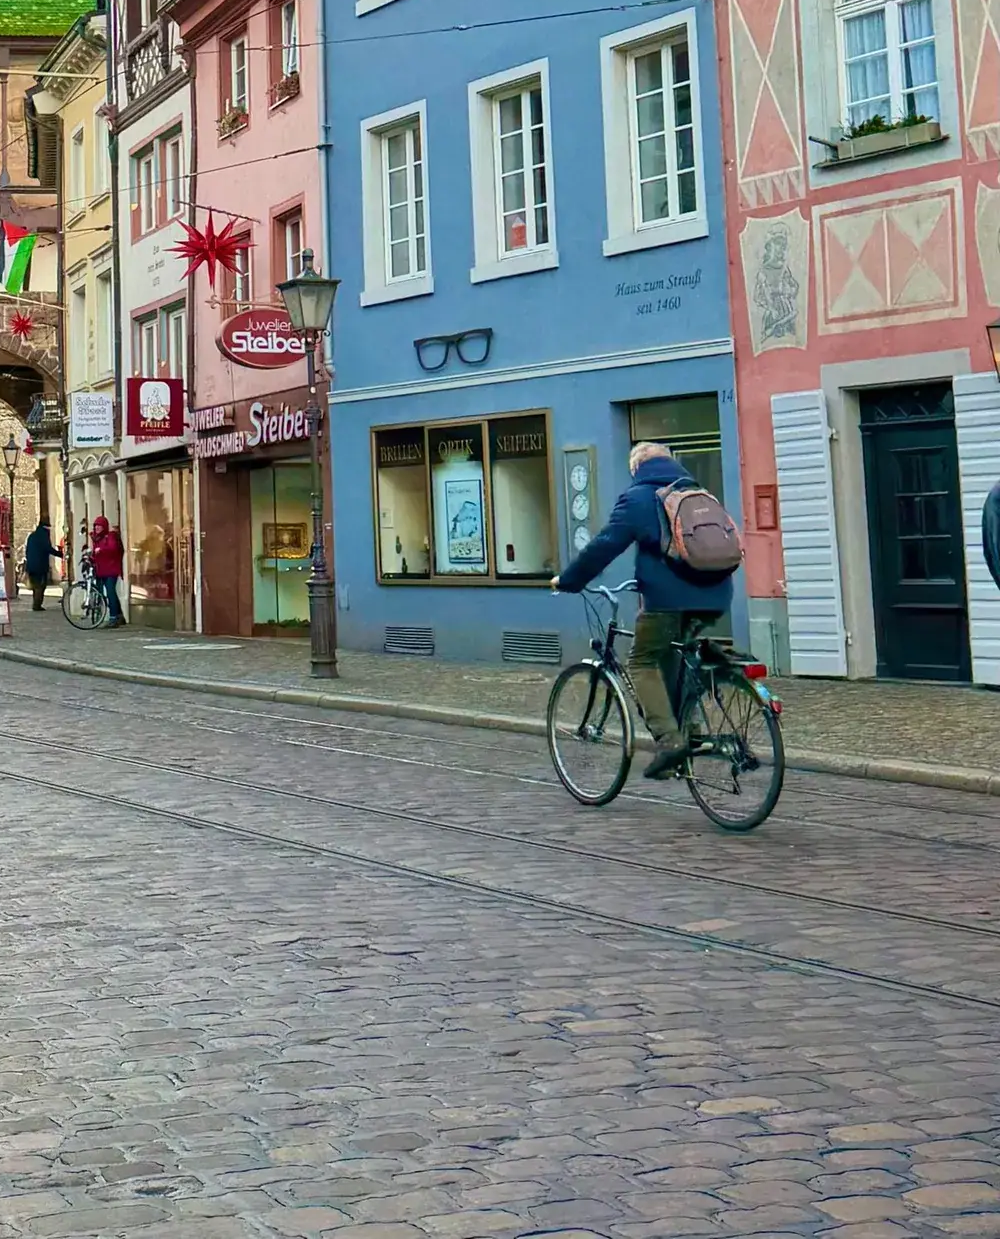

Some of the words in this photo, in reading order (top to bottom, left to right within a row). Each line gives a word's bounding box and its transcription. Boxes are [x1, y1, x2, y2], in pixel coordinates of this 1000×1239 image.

[614, 281, 641, 297] Haus
[643, 279, 664, 292] zum
[666, 268, 702, 289] Strauß
[636, 302, 652, 315] seit
[657, 296, 681, 312] 1460
[244, 318, 292, 332] Juwelier
[194, 431, 244, 458] GOLDSCHMIED
[380, 443, 423, 462] BRILLEN
[438, 439, 474, 456] OPTIK
[496, 433, 544, 453] SEIFERT
